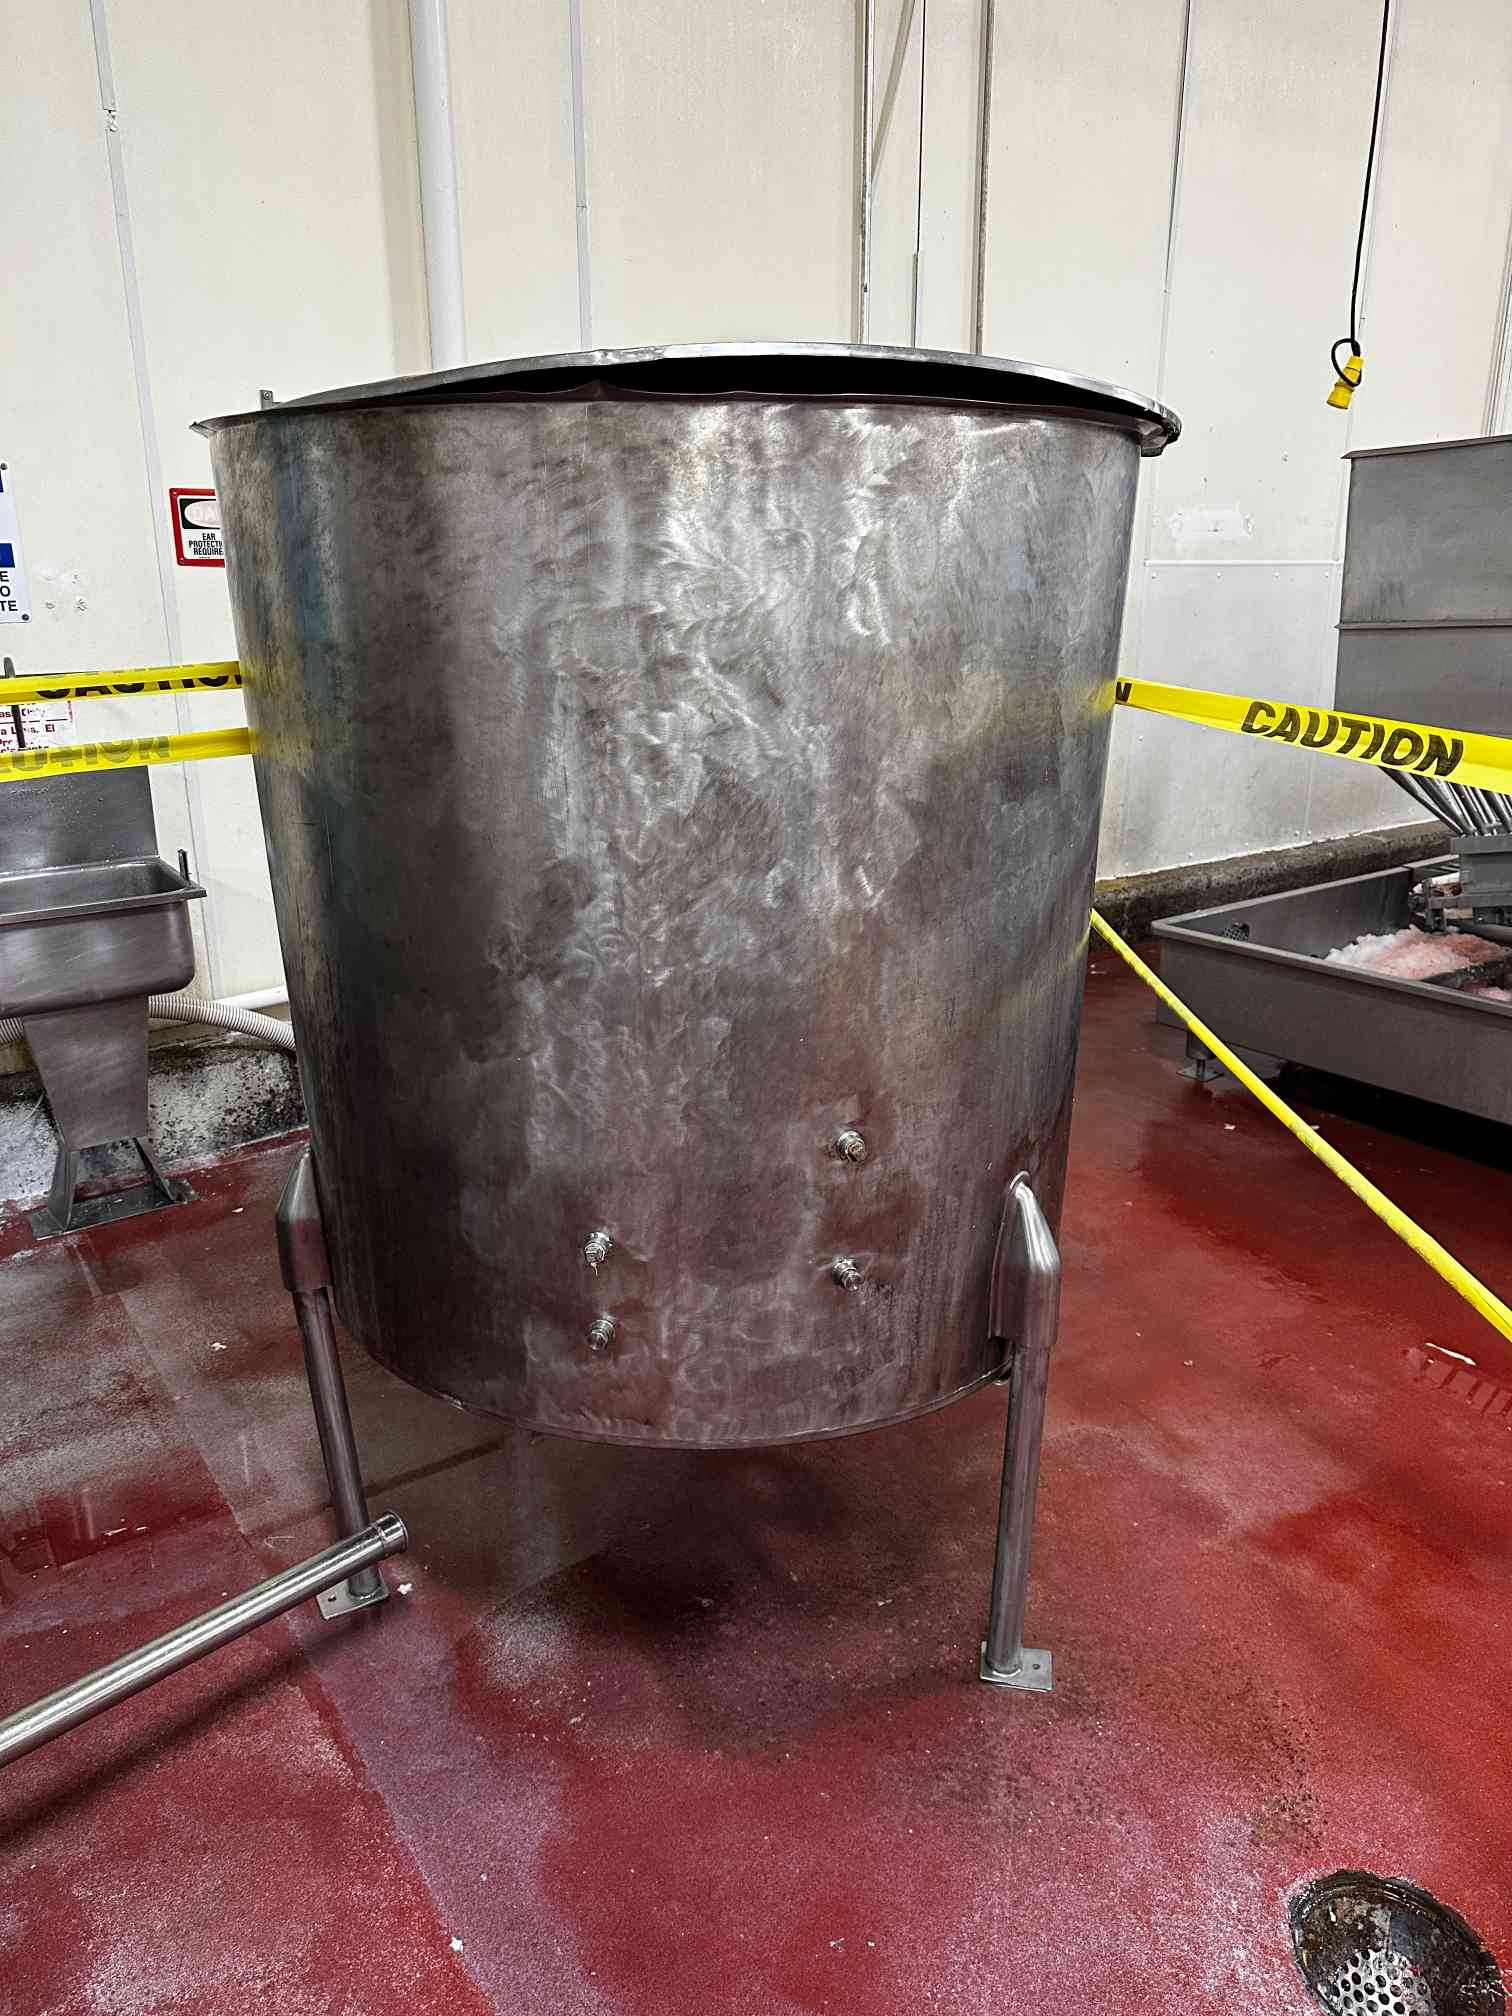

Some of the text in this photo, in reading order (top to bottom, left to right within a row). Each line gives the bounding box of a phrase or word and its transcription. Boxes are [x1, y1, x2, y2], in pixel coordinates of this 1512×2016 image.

[202, 533, 216, 541] EAR
[188, 540, 223, 548] PROTECTI
[1240, 701, 1464, 777] CAUTION
